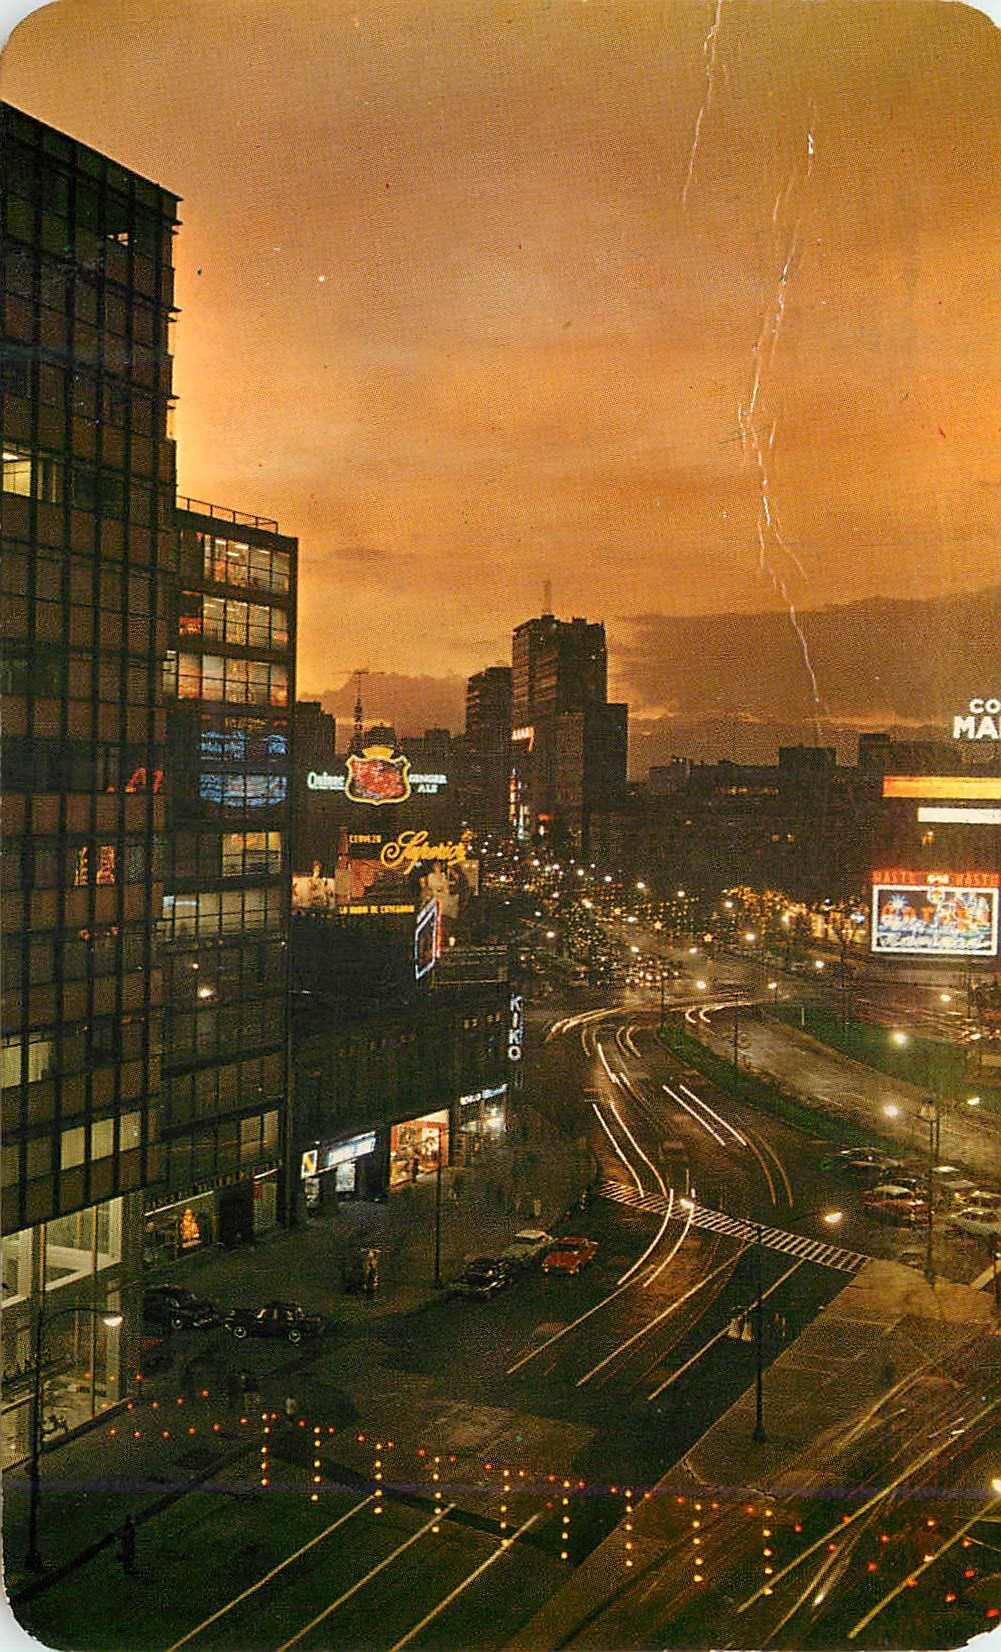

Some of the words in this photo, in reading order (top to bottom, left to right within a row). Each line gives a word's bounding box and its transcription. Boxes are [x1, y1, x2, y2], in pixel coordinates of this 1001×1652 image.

[953, 716, 1001, 740] MA
[380, 830, 467, 875] Superior
[507, 993, 524, 1061] KIKO
